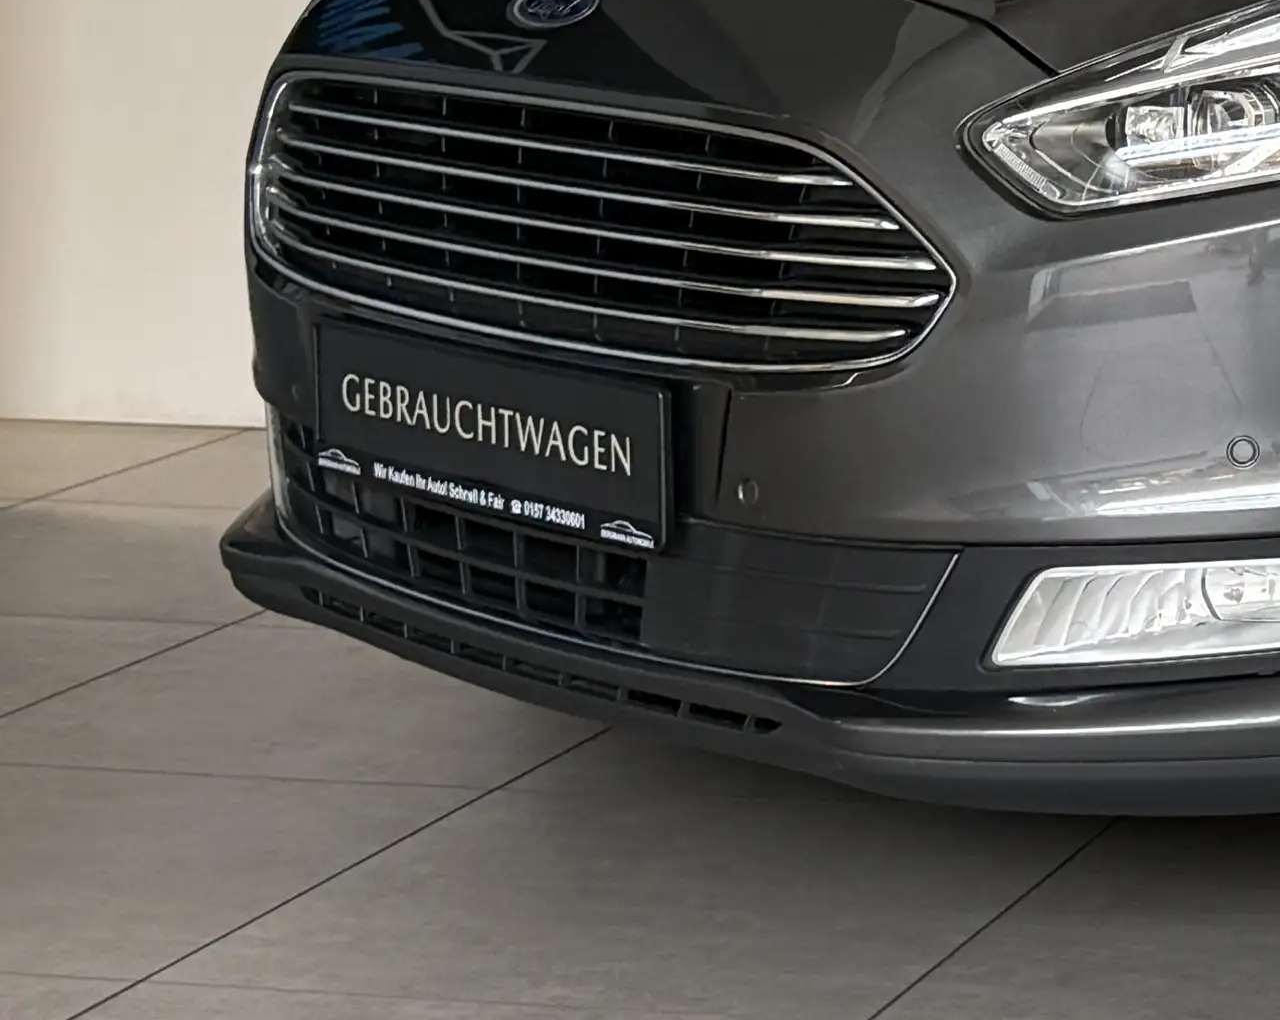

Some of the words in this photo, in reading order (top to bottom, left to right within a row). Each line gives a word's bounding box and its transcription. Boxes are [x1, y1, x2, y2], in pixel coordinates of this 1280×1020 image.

[341, 373, 632, 477] GEBRAUCHTWAGEN
[373, 461, 388, 480] Wir
[487, 491, 505, 510] Fair
